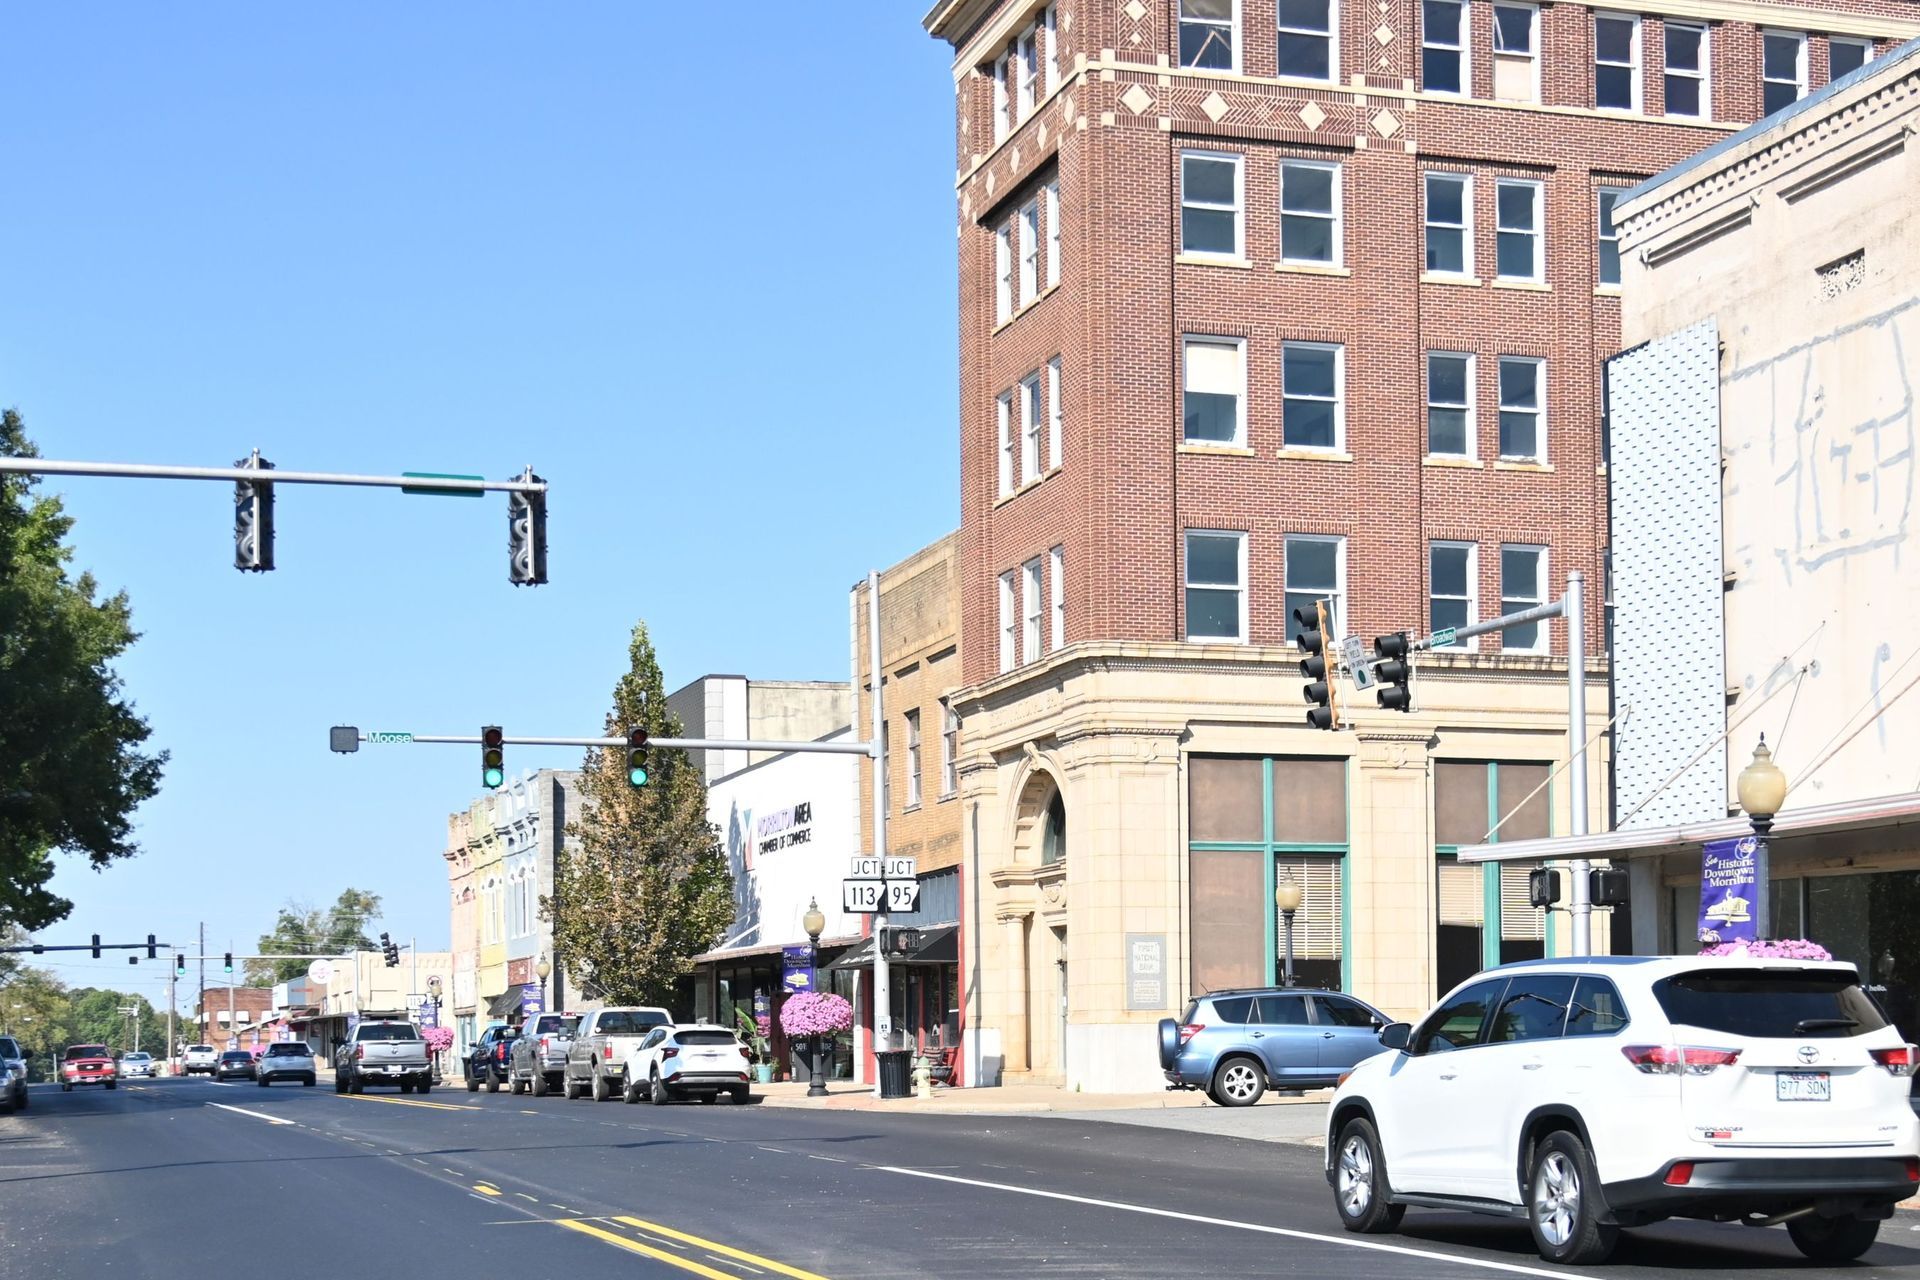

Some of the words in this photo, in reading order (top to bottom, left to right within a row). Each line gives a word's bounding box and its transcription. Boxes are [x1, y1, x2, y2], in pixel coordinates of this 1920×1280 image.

[368, 731, 411, 744] Moose
[793, 801, 812, 826] AREA
[759, 838, 778, 856] CHAMBER
[779, 835, 785, 850] OF
[787, 828, 811, 847] COMMERCE
[853, 860, 878, 874] JCT
[888, 860, 913, 874] JCT
[1705, 854, 1718, 867] See
[1718, 858, 1755, 869] Historic
[1704, 867, 1754, 879] Downtown
[1709, 875, 1754, 887] Morrilton
[852, 886, 876, 905] 113
[893, 886, 911, 905] 95
[1780, 1080, 1800, 1095] 977
